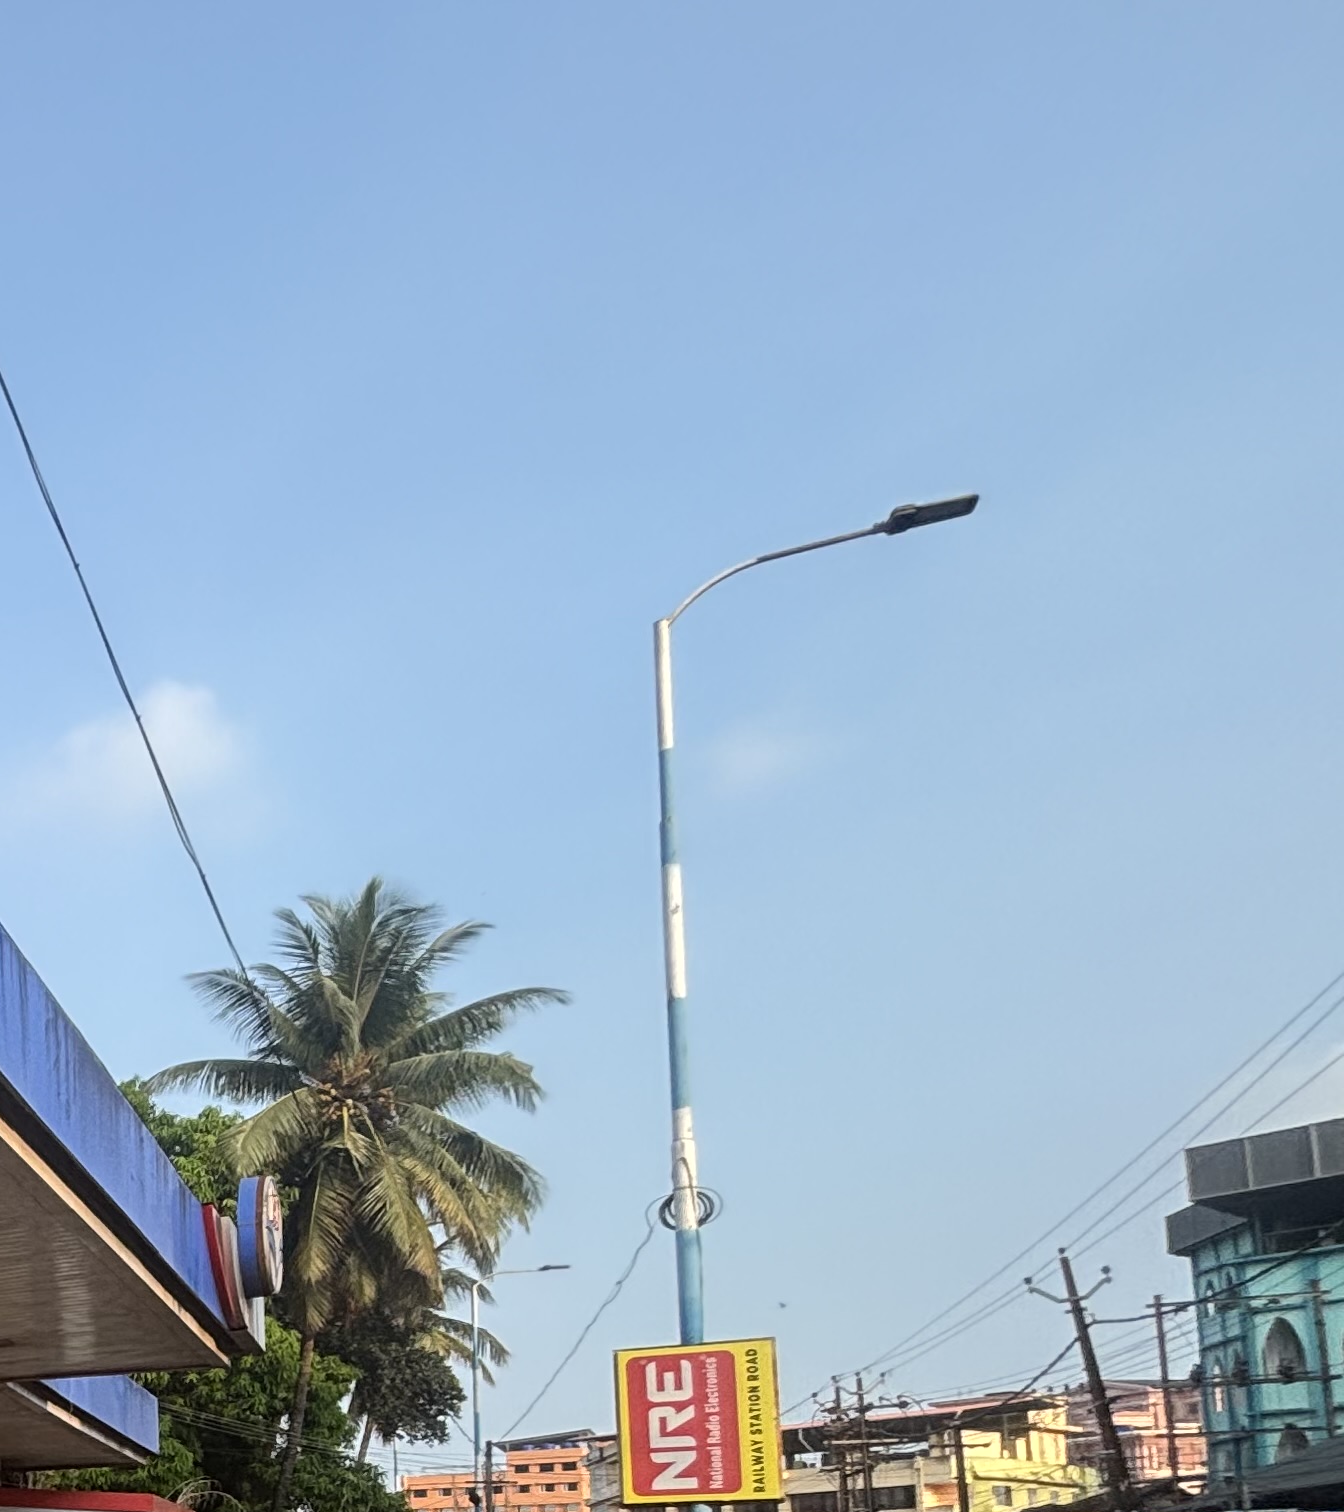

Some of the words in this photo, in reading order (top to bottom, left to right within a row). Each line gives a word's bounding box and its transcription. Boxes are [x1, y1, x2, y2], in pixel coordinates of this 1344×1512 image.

[703, 1356, 720, 1413] Electronics
[745, 1348, 759, 1382] ROAD
[645, 1359, 699, 1491] NRE
[705, 1414, 722, 1444] Radio
[748, 1385, 763, 1436] STATION
[708, 1445, 724, 1490] National
[750, 1440, 766, 1493] RAILWAY
